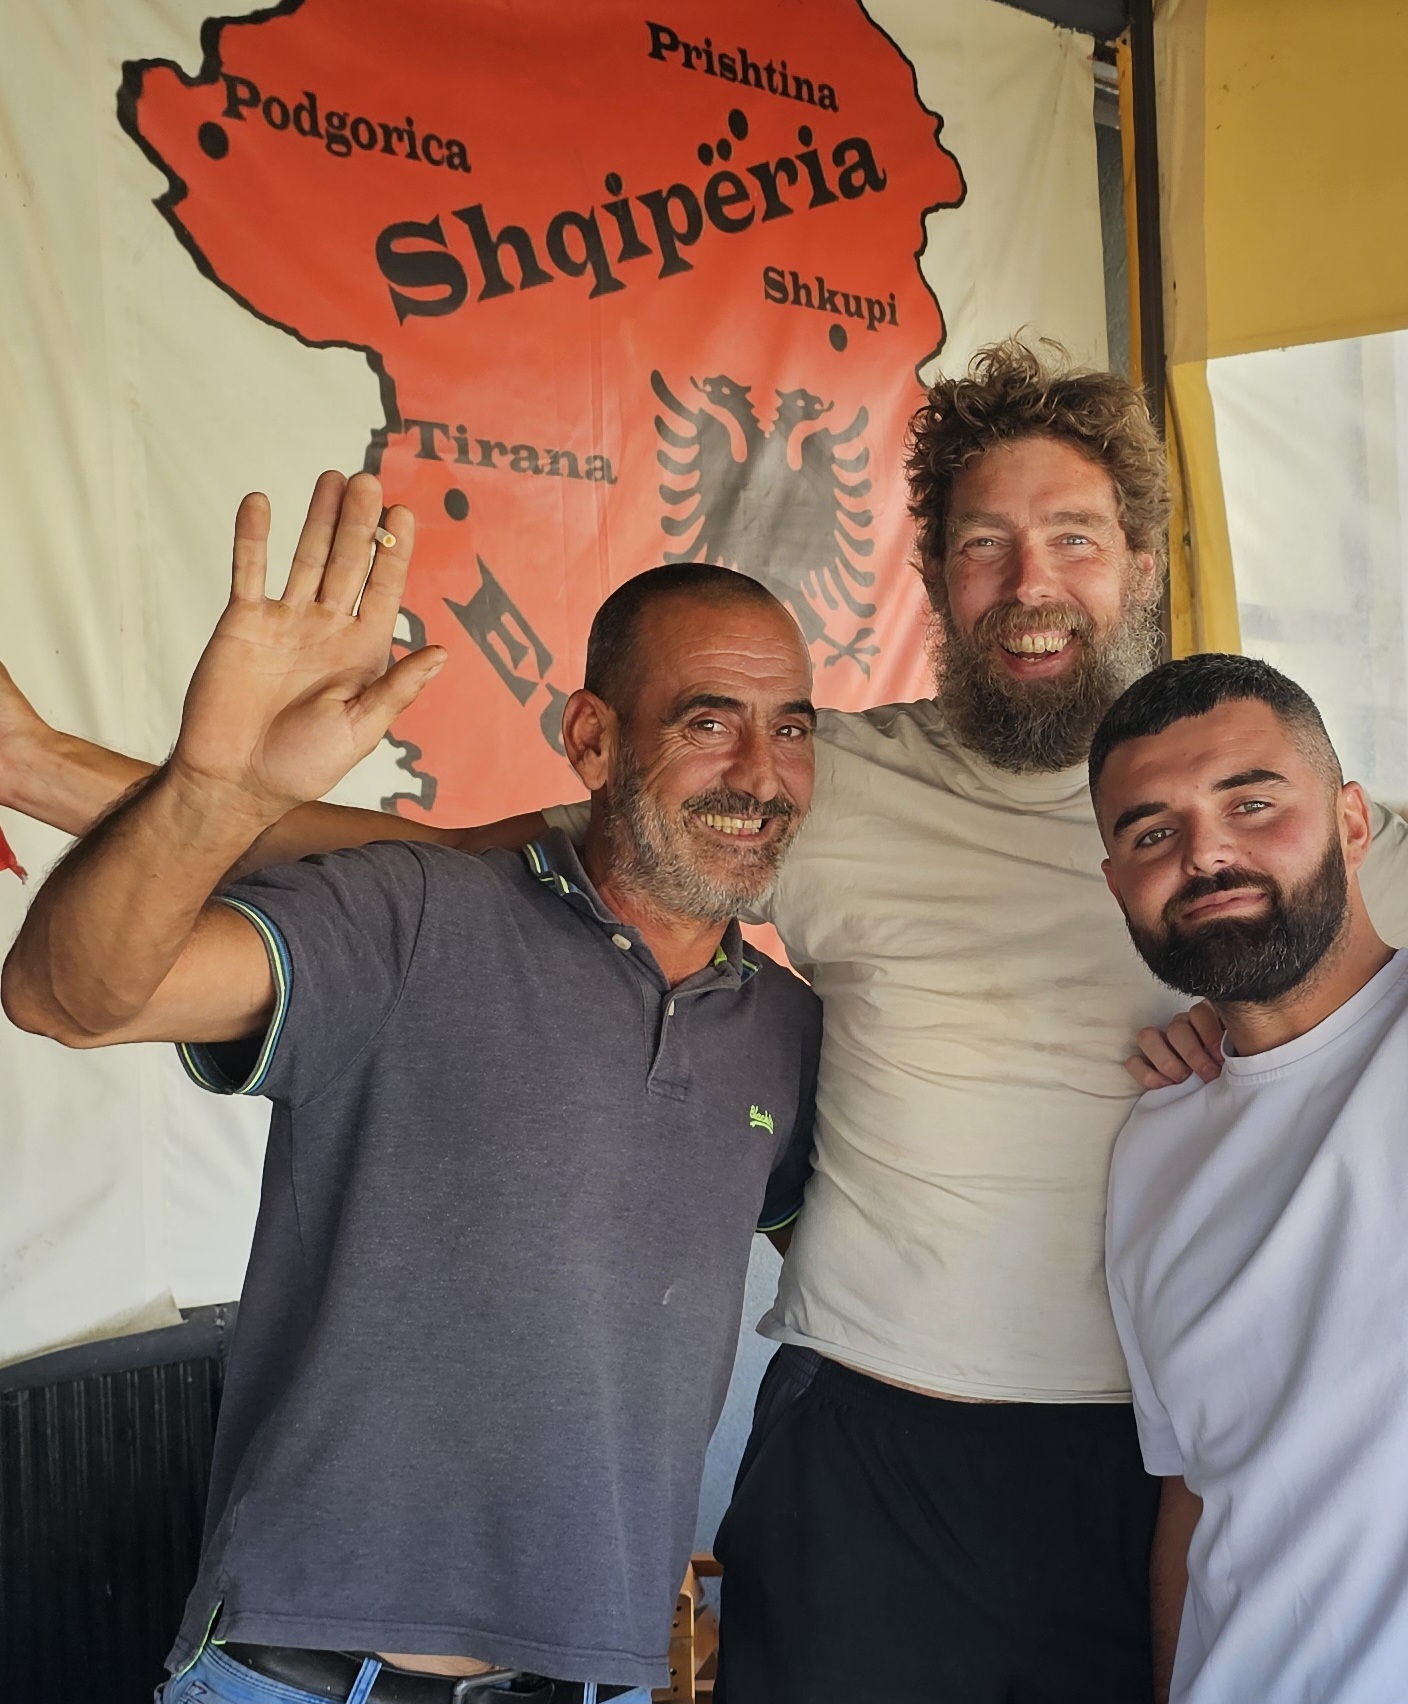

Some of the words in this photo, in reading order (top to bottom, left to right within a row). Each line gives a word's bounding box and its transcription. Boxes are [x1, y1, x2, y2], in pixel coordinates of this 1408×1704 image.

[646, 21, 840, 113] Prishtina
[221, 72, 471, 173] Podgorica
[376, 126, 886, 325] Shqipëria
[763, 266, 899, 331] Shkupi
[405, 418, 618, 485] Tirana
